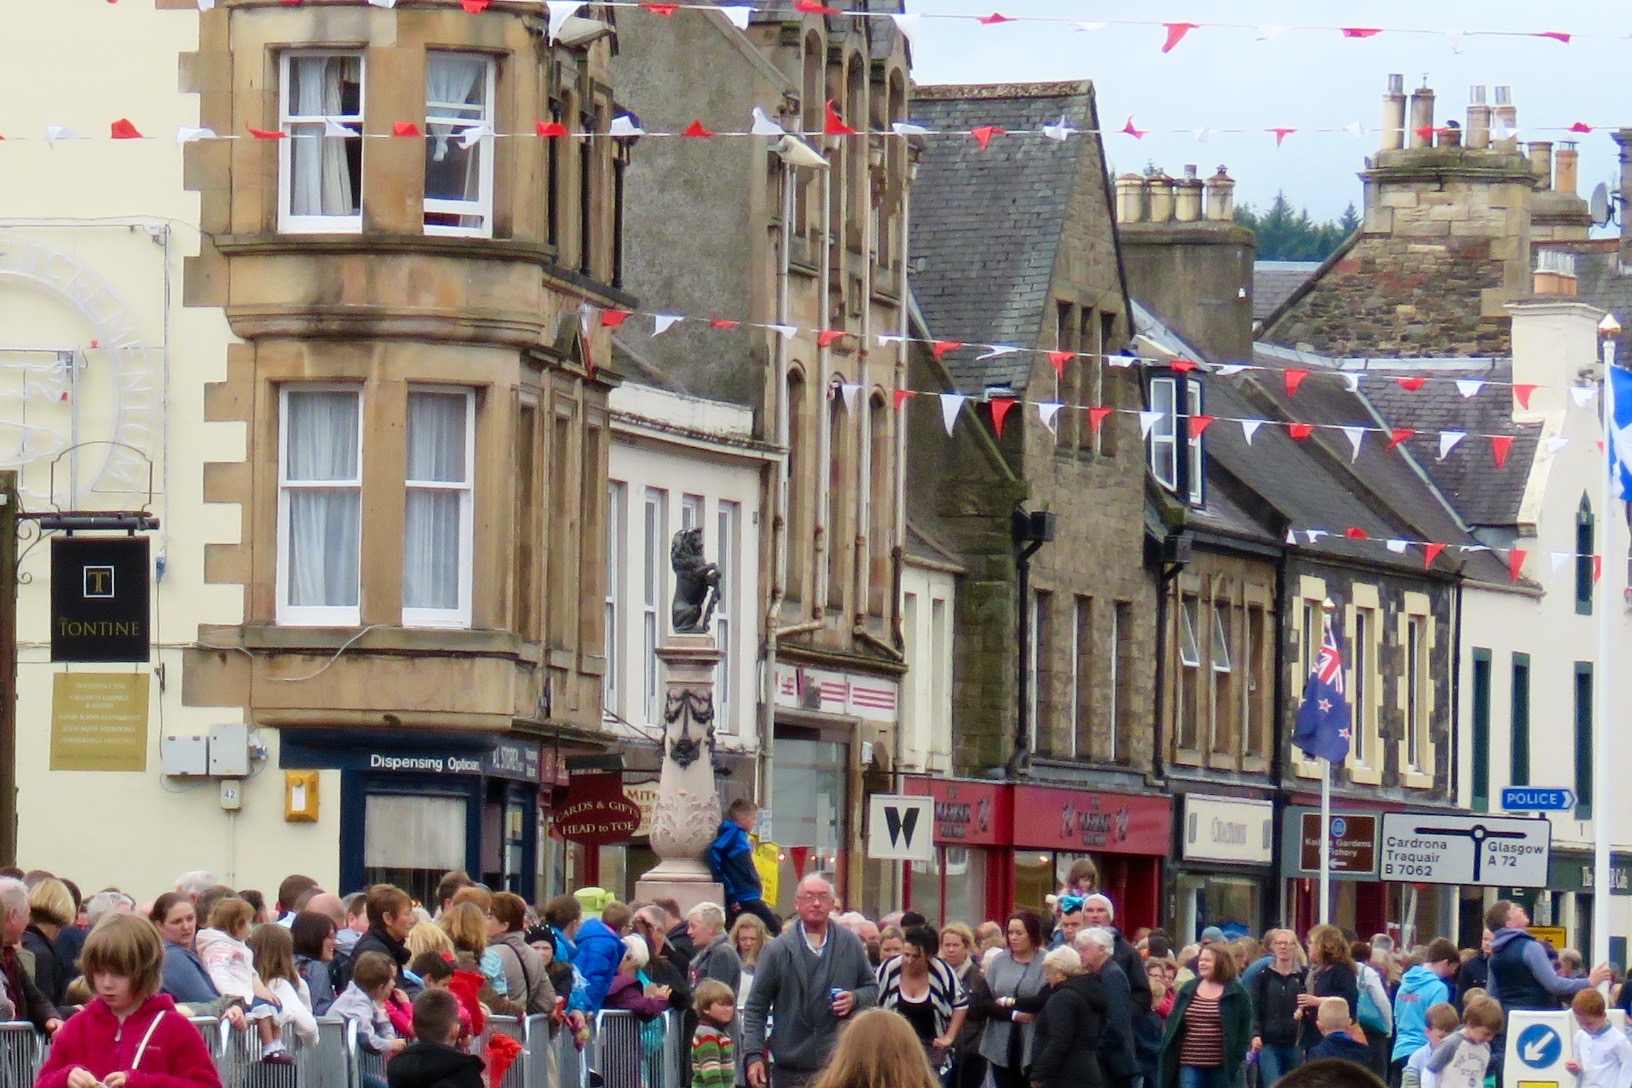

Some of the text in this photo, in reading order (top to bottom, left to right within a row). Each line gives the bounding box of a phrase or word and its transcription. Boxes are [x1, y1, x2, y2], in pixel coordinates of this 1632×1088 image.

[88, 571, 110, 593] T
[59, 621, 140, 636] TONTINE
[371, 754, 443, 772] Dispensing
[224, 790, 235, 799] 42
[1506, 793, 1558, 804] POLICE
[555, 801, 594, 823] CARDS
[596, 801, 605, 809] &
[608, 801, 639, 819] GIFTS
[562, 821, 635, 835] HEAD to TOE
[883, 807, 920, 850] W
[1336, 838, 1372, 848] Gardens
[1387, 837, 1448, 850] Cardrona
[1488, 842, 1544, 857] Glasgow
[1387, 850, 1441, 863] Traquair
[1488, 856, 1517, 867] A 72
[1385, 864, 1433, 877] B 7062
